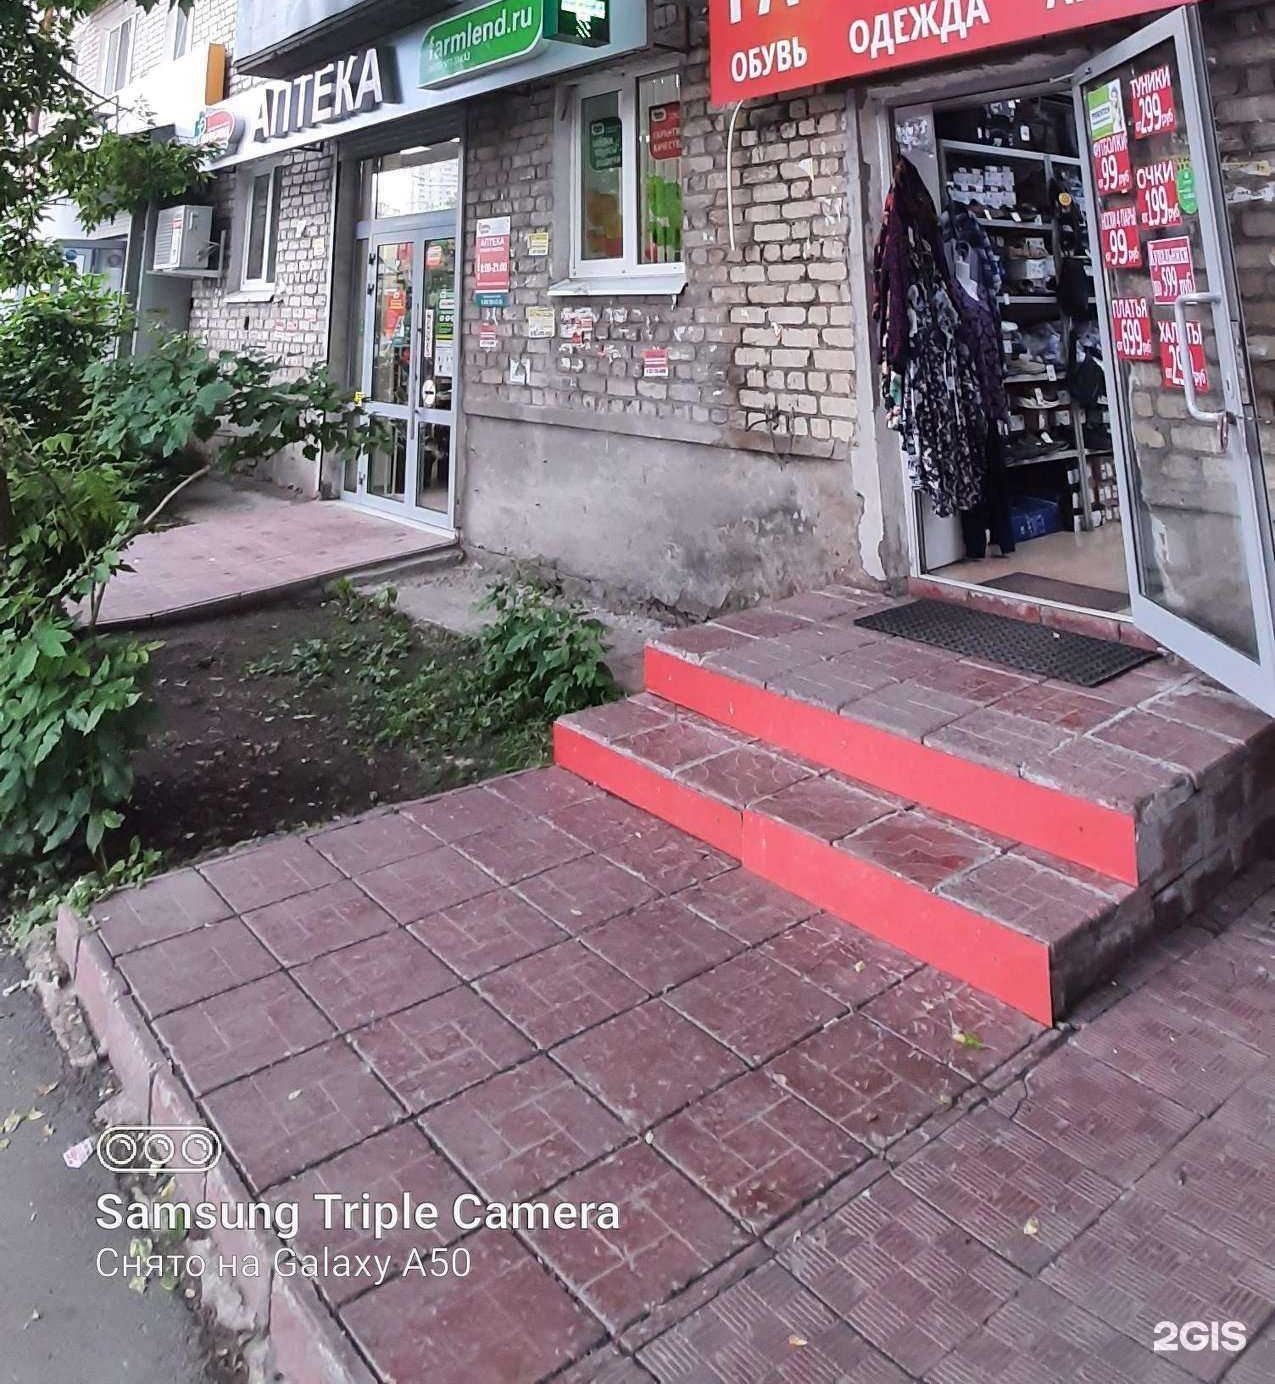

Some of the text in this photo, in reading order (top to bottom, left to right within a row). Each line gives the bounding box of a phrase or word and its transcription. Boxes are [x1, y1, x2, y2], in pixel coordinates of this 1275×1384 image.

[428, 6, 532, 60] farmlend.ru
[730, 36, 808, 83] ОБУВЬ
[253, 48, 383, 138] АПТЕКА
[1130, 66, 1171, 99] ТУНИКИ
[1139, 93, 1162, 134] 299
[1161, 110, 1174, 128] руб
[1101, 154, 1118, 190] 99
[1136, 161, 1175, 189] ОЧКИ
[1145, 186, 1168, 226] 199
[1168, 203, 1180, 222] руб
[1109, 228, 1128, 265] 99
[1161, 266, 1178, 296] 599
[1112, 298, 1147, 319] ПЛАТЬЯ
[1122, 319, 1143, 356] 699
[1157, 321, 1203, 345] ХАЛТЫ
[1169, 344, 1194, 386] 29
